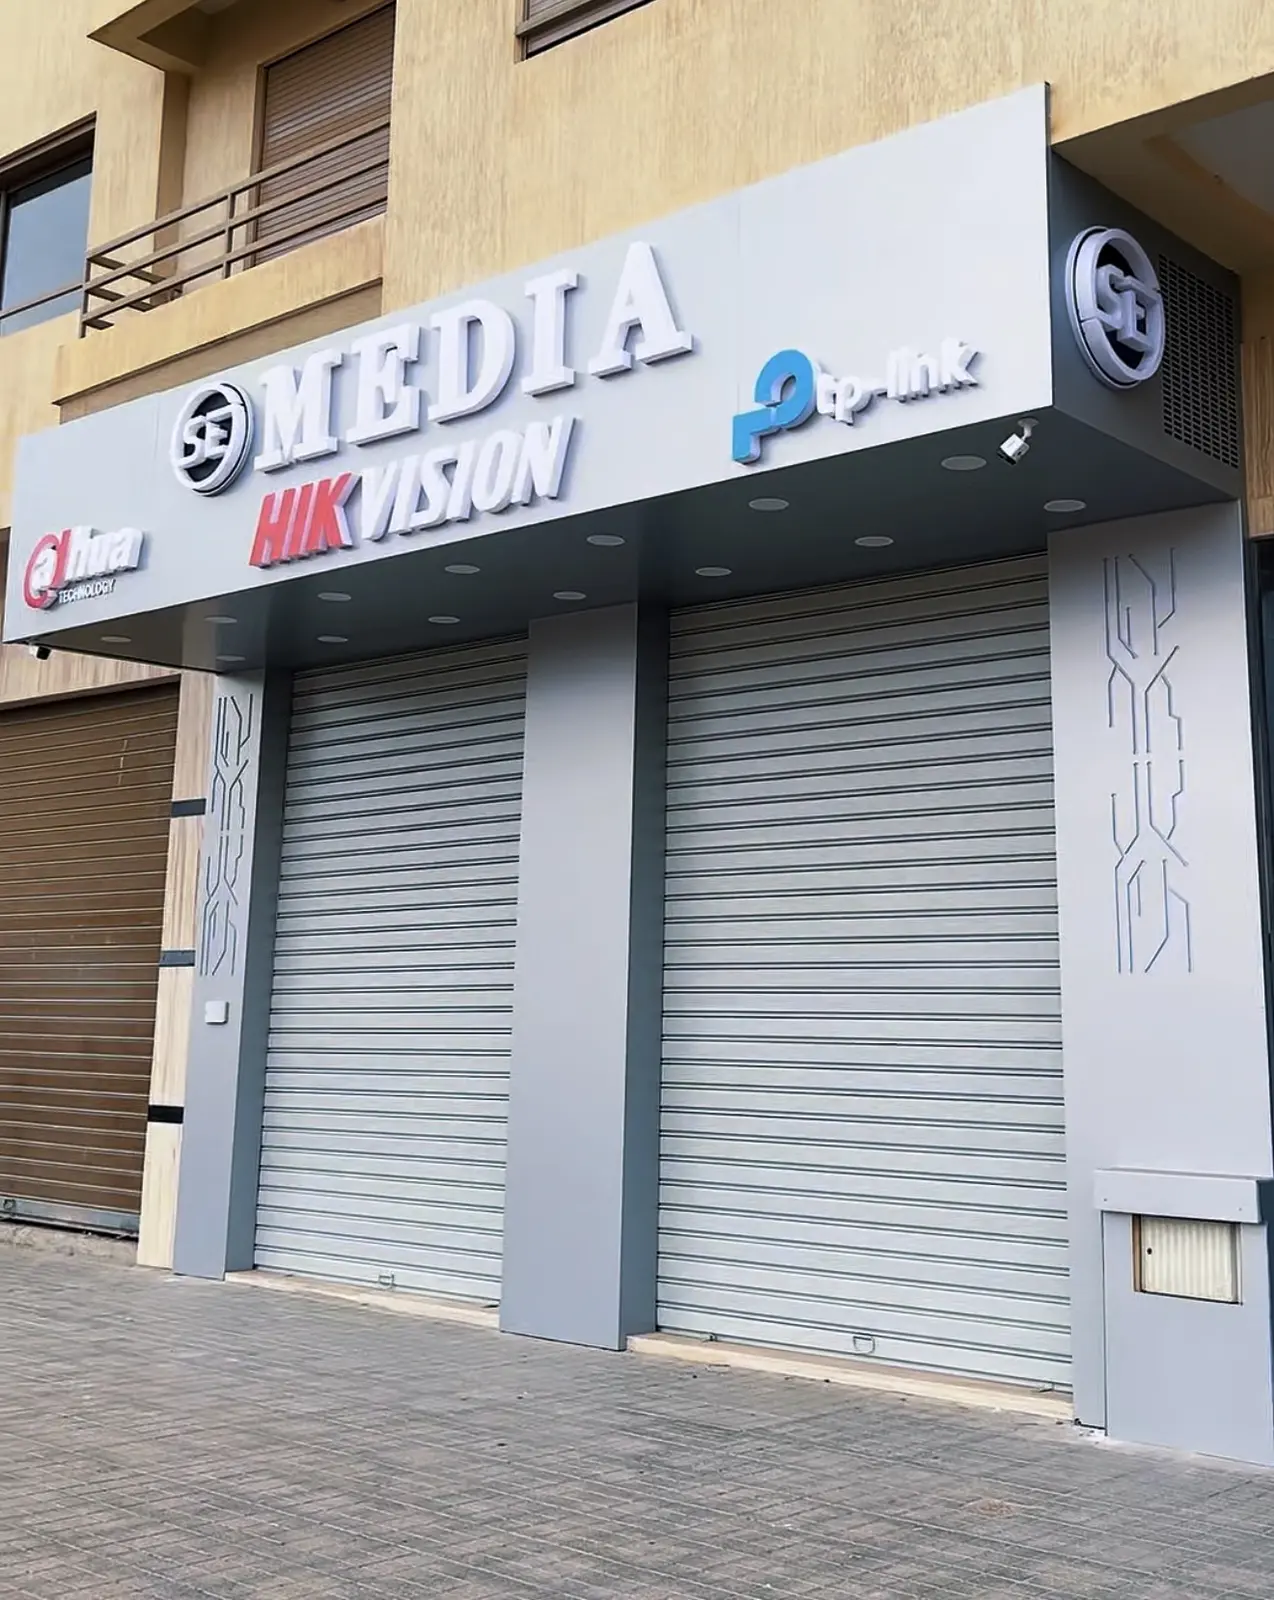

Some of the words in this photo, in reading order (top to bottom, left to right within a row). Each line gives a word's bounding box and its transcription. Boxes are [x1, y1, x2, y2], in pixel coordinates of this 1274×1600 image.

[254, 241, 694, 473] MEDIA
[249, 415, 577, 569] HIKVISION
[58, 579, 116, 604] TECHNOLOGY
